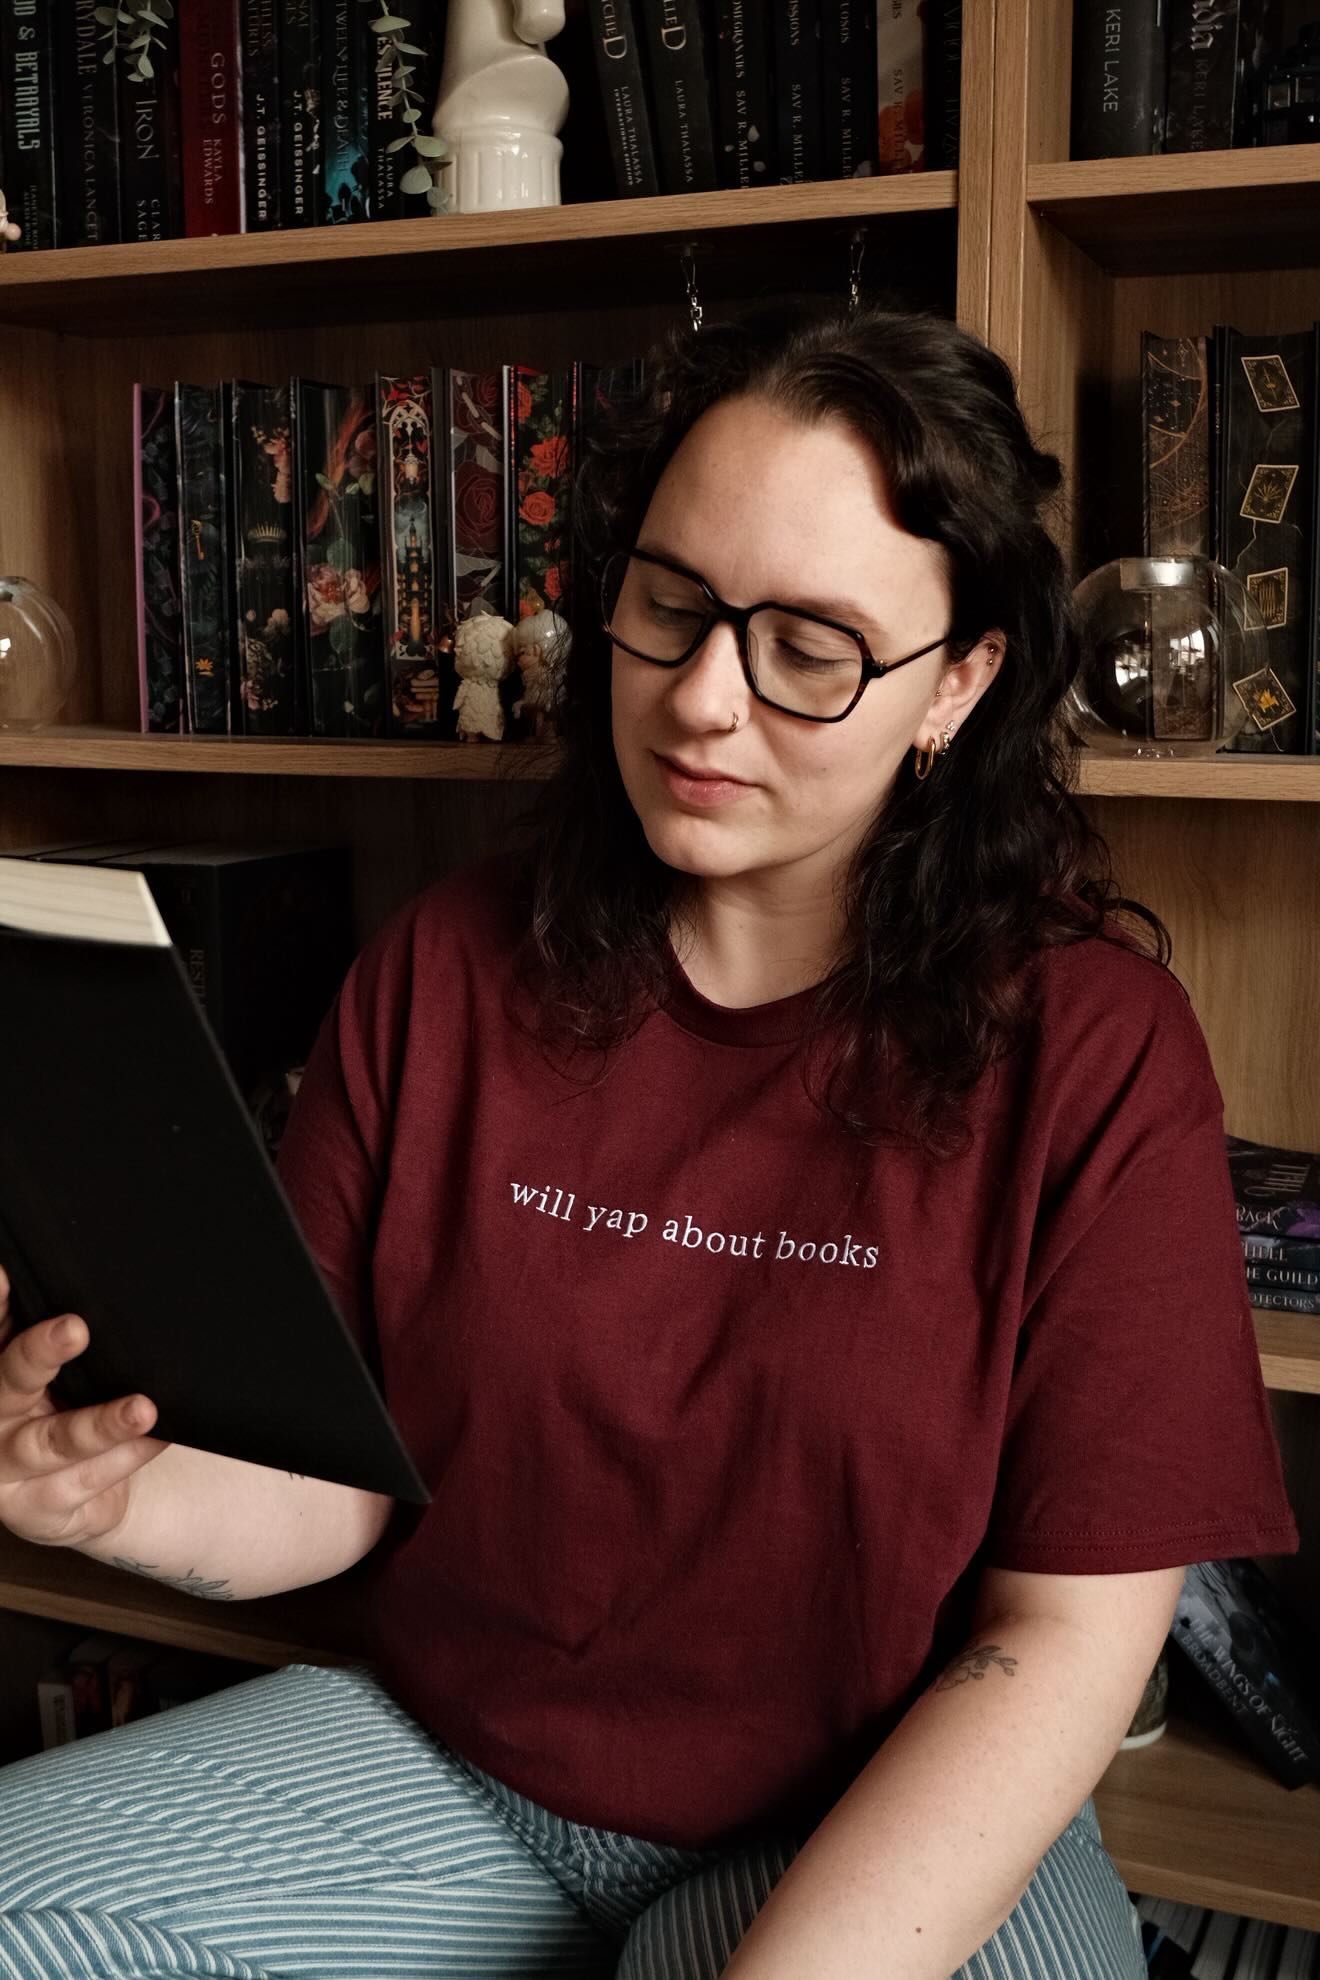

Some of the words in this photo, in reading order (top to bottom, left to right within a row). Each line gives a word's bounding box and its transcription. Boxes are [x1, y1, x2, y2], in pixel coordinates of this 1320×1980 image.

[17, 25, 35, 40] &
[1104, 8, 1121, 52] KERI
[15, 51, 41, 151] BETRAYALS
[210, 52, 226, 125] GODS
[674, 80, 685, 119] LAURA
[735, 90, 746, 115] SAV
[791, 84, 802, 109] SAV
[840, 76, 851, 103] SAV
[894, 69, 904, 95] SAV
[1102, 61, 1120, 112] LAKE
[1193, 59, 1209, 97] KERI
[81, 83, 97, 173] VERONICA
[256, 93, 265, 120] J.T.
[293, 90, 303, 117] J.T.
[614, 88, 629, 151] INTERNATIONAL
[736, 121, 748, 136] R.
[135, 99, 160, 160] IRON
[621, 86, 633, 123] LAURA
[627, 127, 642, 184] THALASSA
[679, 123, 696, 184] THALASSA
[841, 128, 853, 178] MILLE
[203, 139, 215, 205] EDWARDS
[213, 139, 224, 182] KAYLA
[256, 125, 267, 219] GEISSINGER
[293, 122, 304, 215] GEISSINGER
[376, 146, 386, 209] THALASSA
[387, 156, 397, 198] LAURA
[737, 140, 750, 189] MILLE
[792, 134, 804, 184] MILLE
[83, 179, 99, 241] LANCET
[510, 1182, 576, 1221] will
[583, 1204, 649, 1238] yap
[662, 1216, 766, 1259] about
[775, 1231, 880, 1269] books
[1266, 1269, 1319, 1286] GUILD
[1181, 1633, 1250, 1715] BROADBENT
[1213, 1645, 1254, 1696] WINGS
[1248, 1695, 1273, 1717] OF
